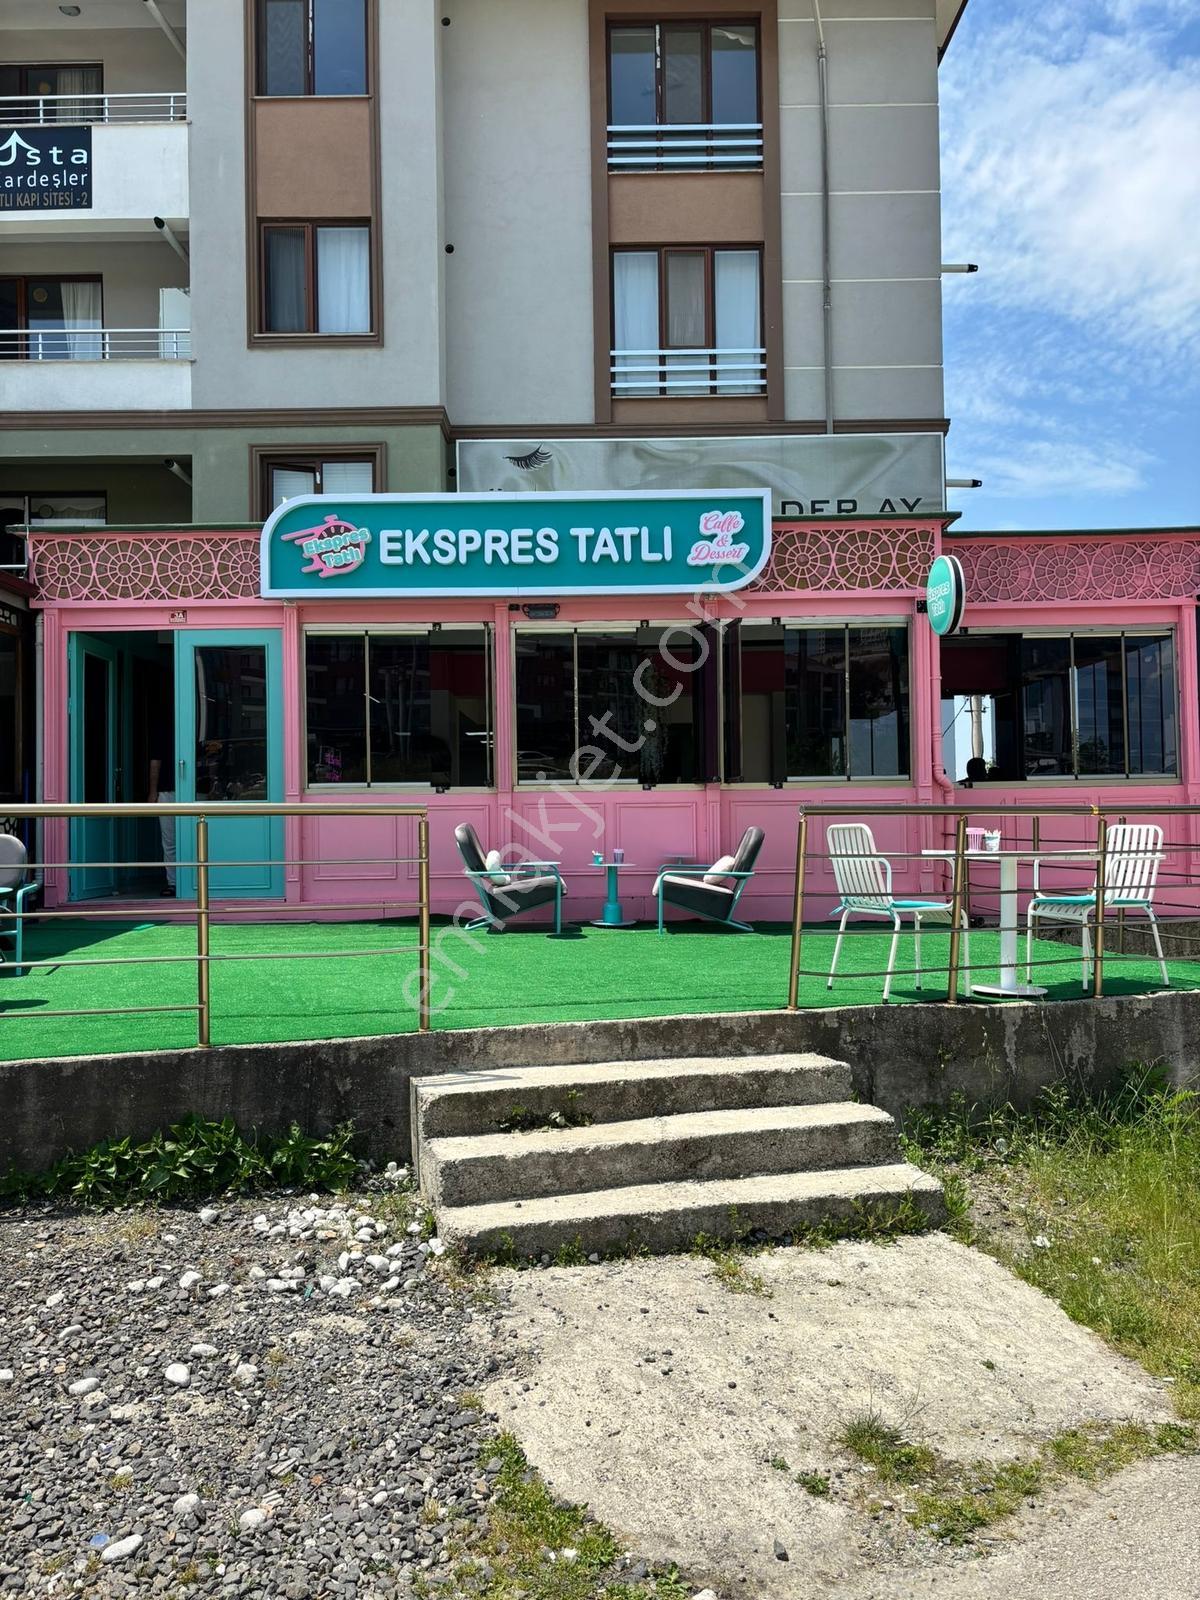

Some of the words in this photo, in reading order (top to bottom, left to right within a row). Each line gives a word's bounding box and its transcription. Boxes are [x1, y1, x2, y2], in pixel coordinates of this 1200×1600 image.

[0, 169, 88, 188] ardeşler
[16, 192, 40, 207] KAPI
[43, 188, 74, 206] SİTESİ
[703, 513, 742, 533] Caffe
[303, 528, 370, 555] Ekspres
[379, 527, 559, 565] EKSPRES
[569, 526, 672, 563] TATLI
[716, 533, 729, 547] &
[690, 543, 746, 561] Dessert
